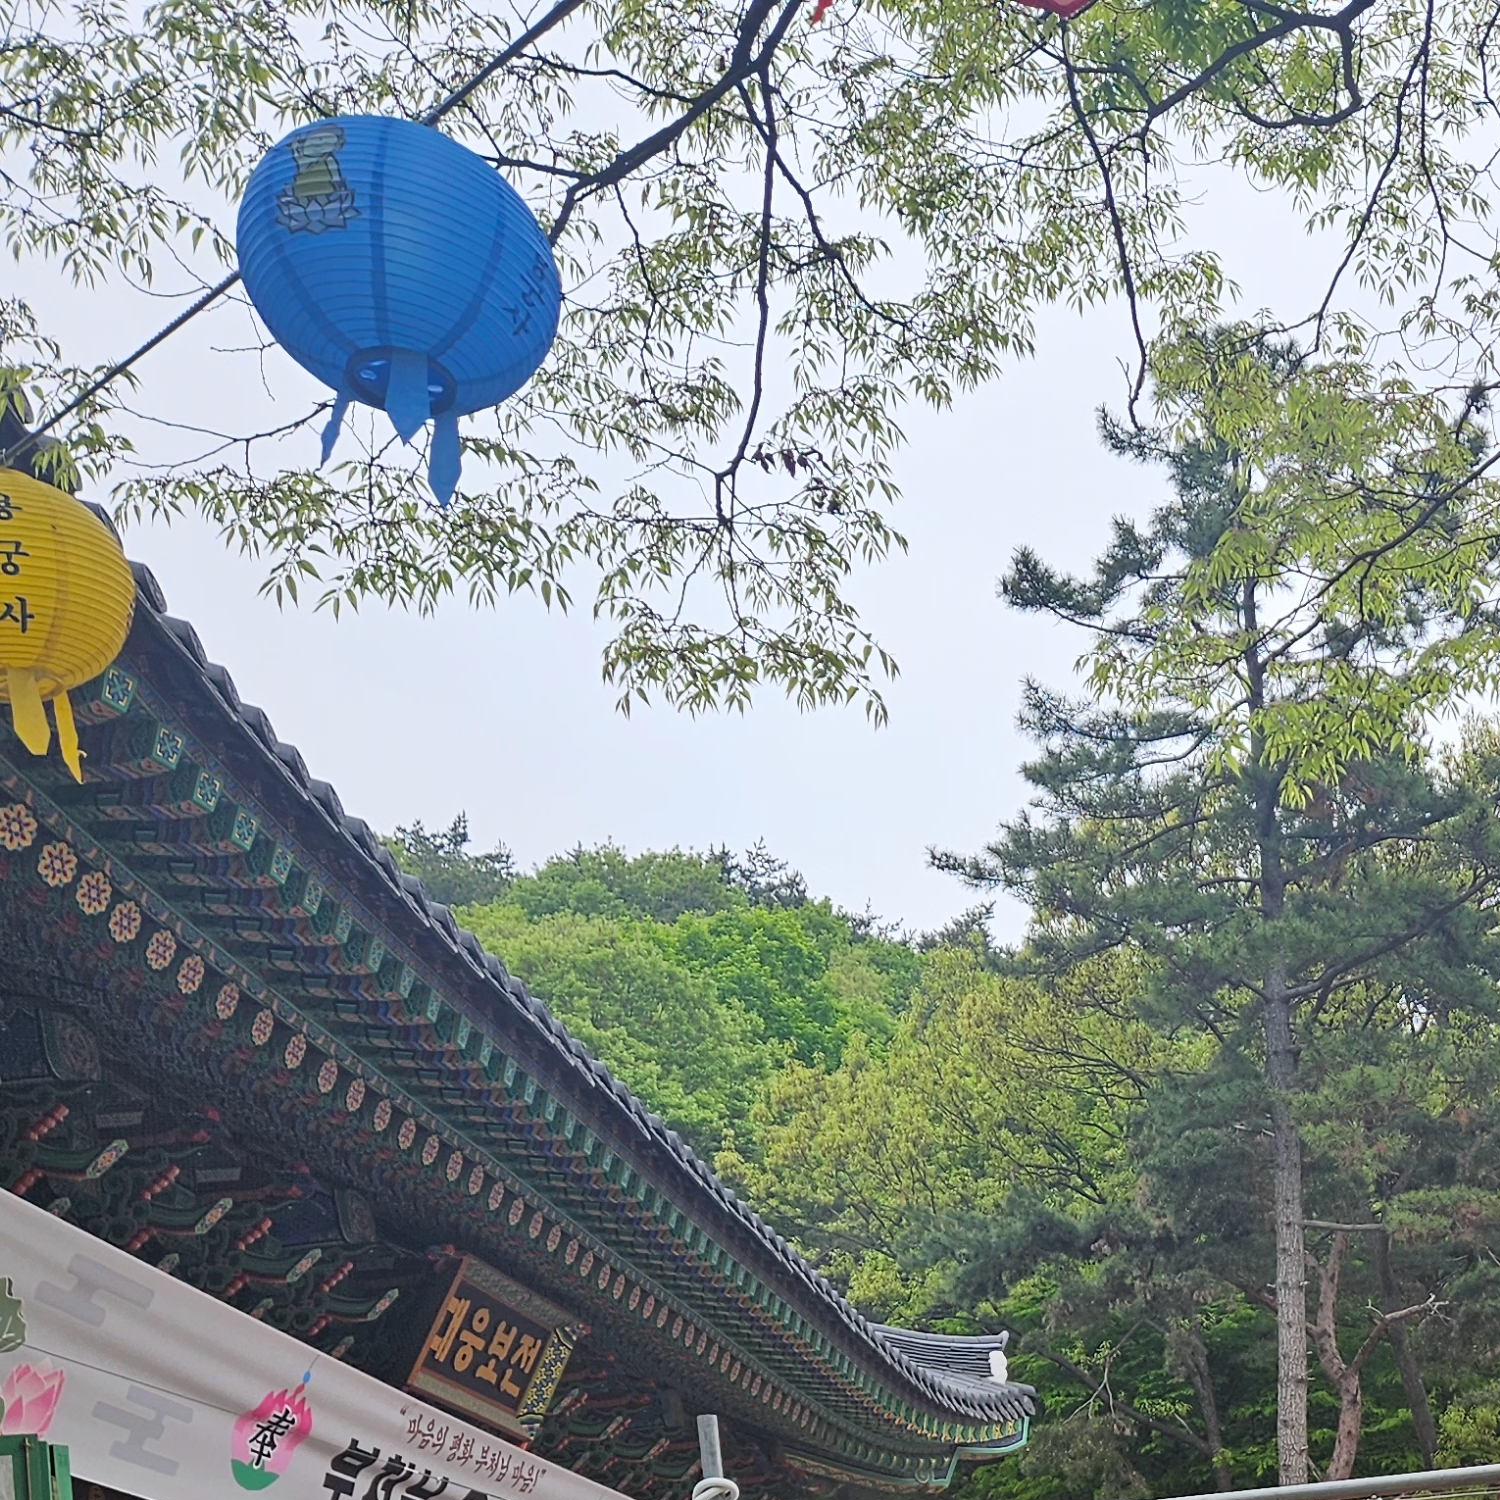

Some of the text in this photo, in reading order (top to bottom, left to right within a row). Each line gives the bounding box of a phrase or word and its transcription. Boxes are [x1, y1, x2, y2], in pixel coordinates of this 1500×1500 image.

[430, 1296, 542, 1398] 대웅보전
[248, 1407, 297, 1467] 奉
[446, 1432, 476, 1467] 평화
[474, 1446, 512, 1482] 부처님
